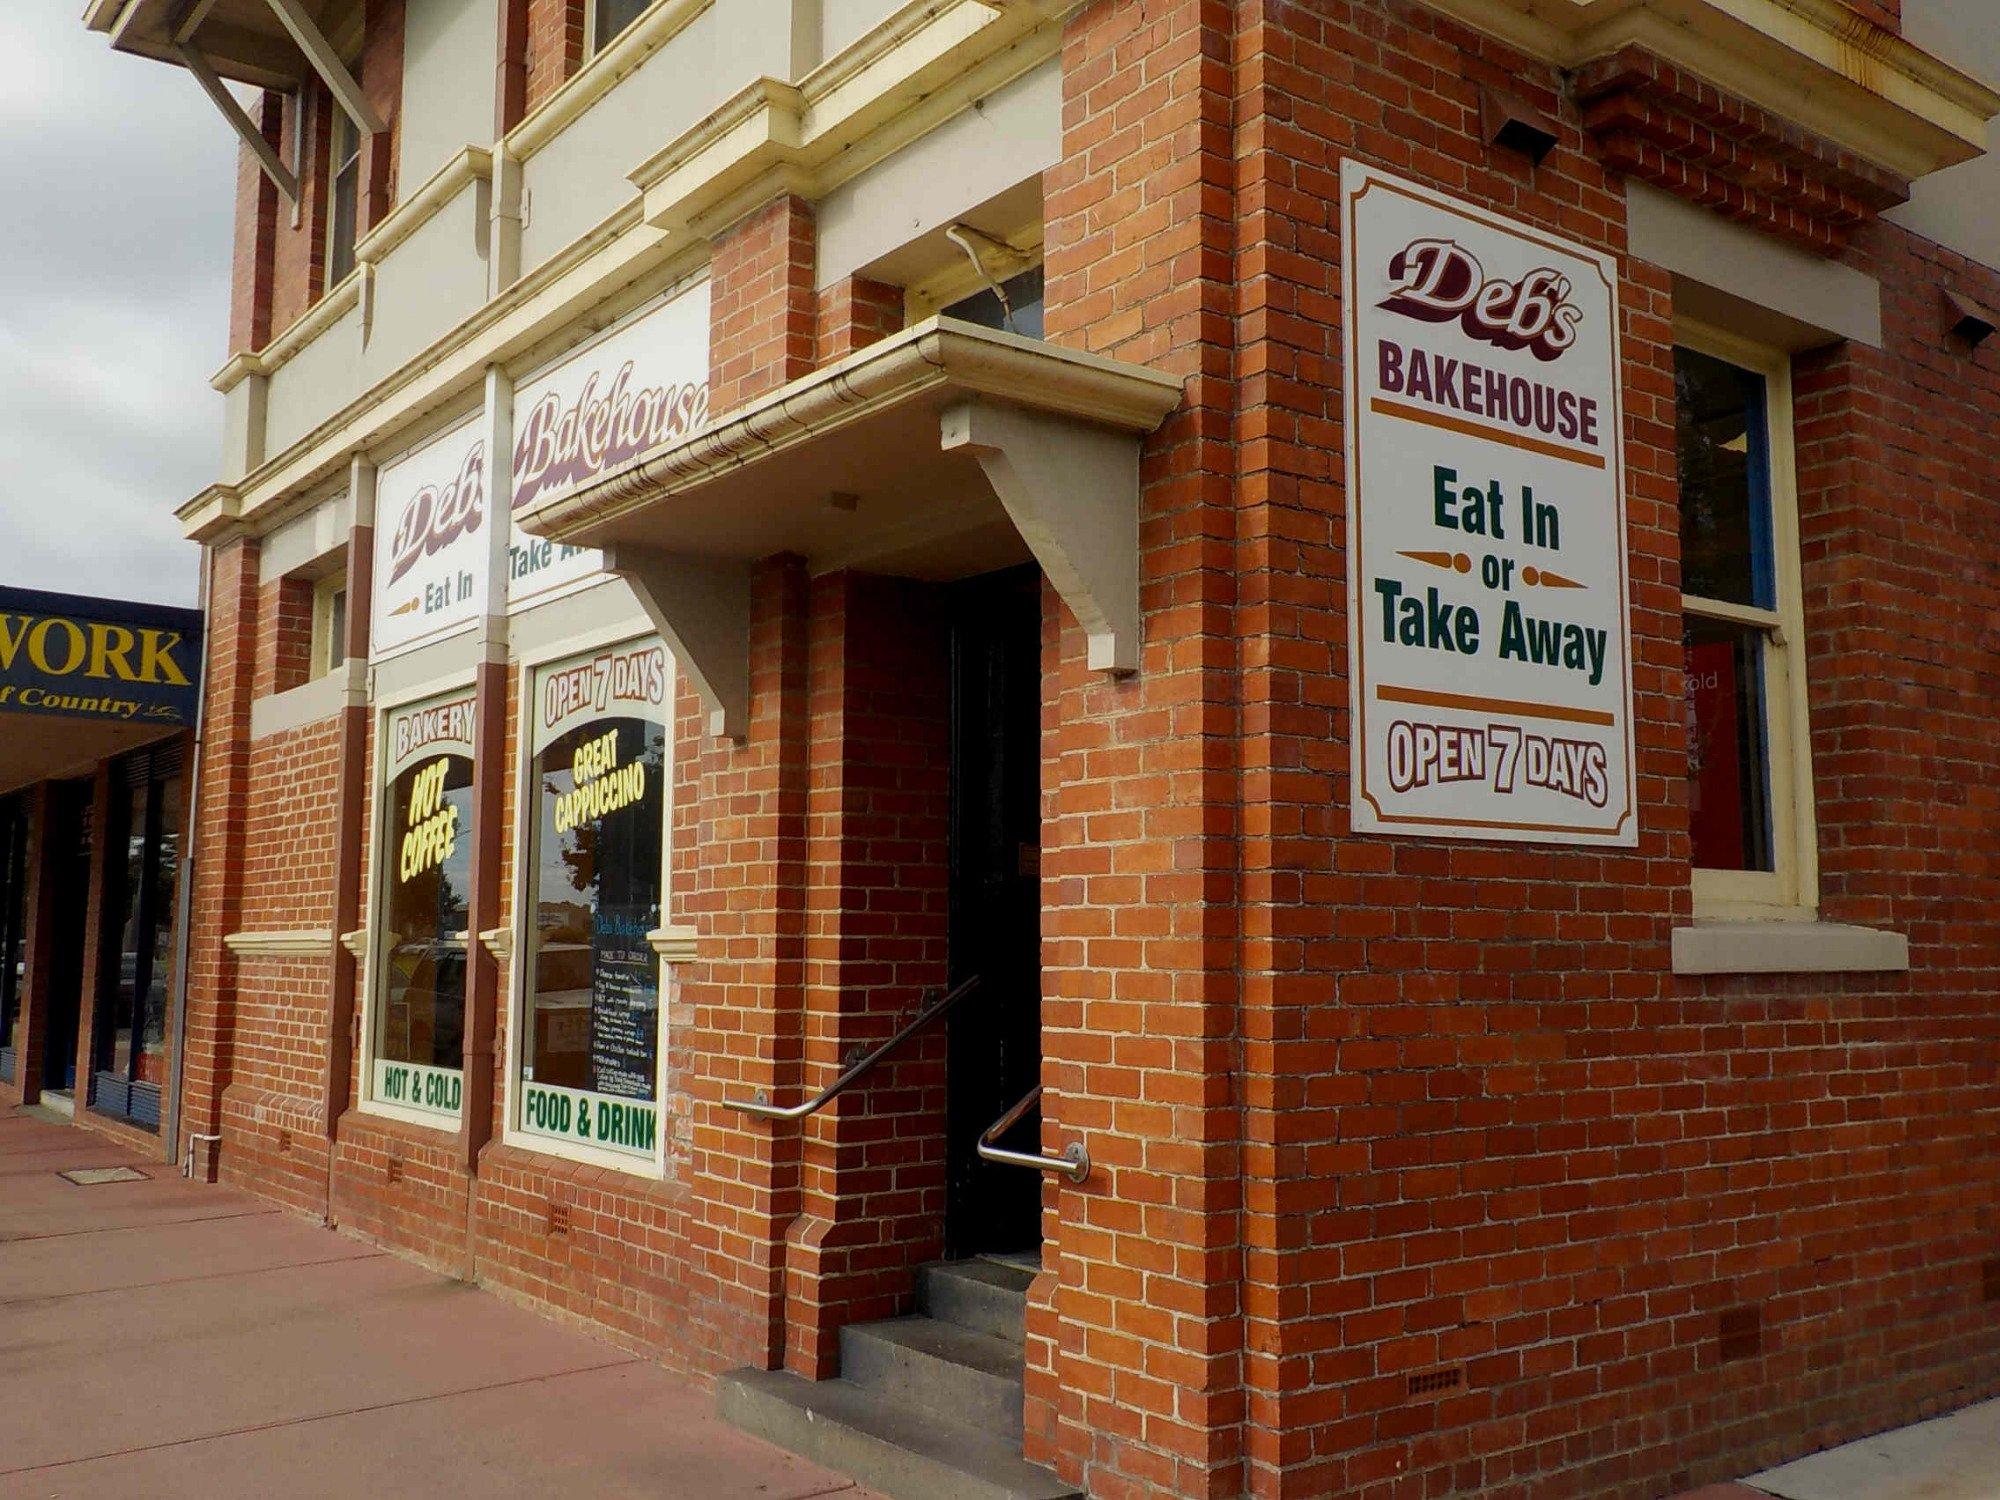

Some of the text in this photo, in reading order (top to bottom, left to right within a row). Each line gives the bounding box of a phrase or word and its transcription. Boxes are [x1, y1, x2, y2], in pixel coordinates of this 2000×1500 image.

[1374, 238, 1584, 362] Deb's
[1378, 338, 1599, 446] BAKEHOUSE
[512, 360, 709, 506] Bakehouse
[1433, 464, 1560, 550] Eat In
[425, 569, 473, 615] Eat In
[509, 539, 552, 580] Take
[1481, 553, 1515, 591] or
[1374, 577, 1608, 686] Take Away
[19, 687, 142, 719] Country
[545, 646, 665, 729] OPEN 7 DAYS
[396, 698, 476, 764] BAKERY
[573, 728, 619, 785] GREAT
[1387, 720, 1608, 808] OPEN 7 DAYS
[409, 757, 450, 827] HOT
[554, 760, 645, 834] CAPPUCCINO
[400, 805, 458, 884] COFFEE
[384, 1066, 462, 1112] HOT & COLD
[526, 1089, 572, 1133] FOOD
[577, 1098, 591, 1138] &
